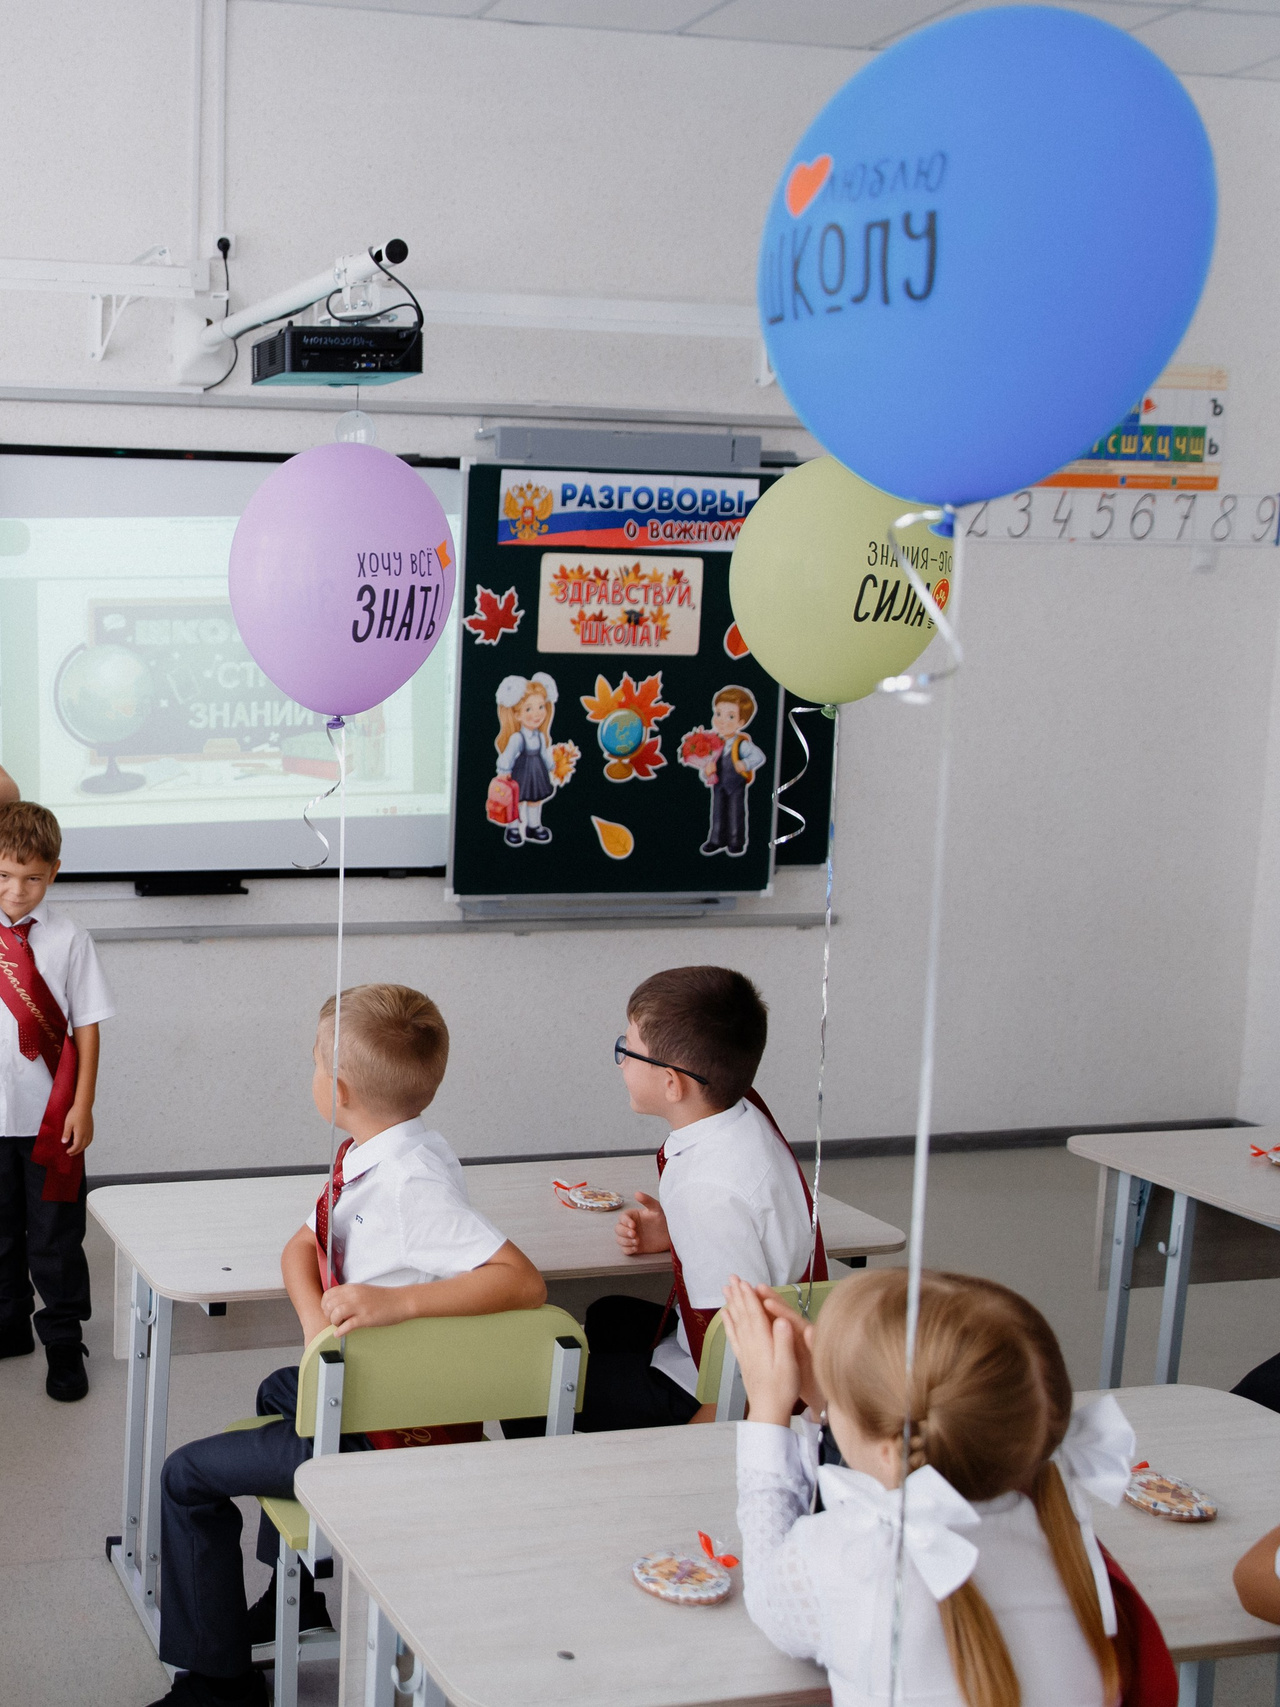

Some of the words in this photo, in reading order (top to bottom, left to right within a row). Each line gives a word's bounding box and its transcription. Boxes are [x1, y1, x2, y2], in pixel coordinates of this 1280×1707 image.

[763, 210, 937, 326] ШКОЛУ
[561, 483, 745, 514] РАЗГОВОРЫ
[1007, 491, 1033, 538] 3
[1052, 491, 1073, 538] 4
[1090, 492, 1118, 539] 5
[1129, 492, 1156, 541] 6
[1175, 493, 1198, 540] 7
[1211, 495, 1238, 541] 8
[1252, 495, 1277, 542] 9
[357, 552, 402, 577] ХОЧУ
[410, 548, 433, 577] ВСЁ
[352, 584, 440, 643] ЗНАТЬ
[555, 577, 696, 610] ЗДРАВСТВУЙ,
[853, 574, 930, 627] СИЛА
[580, 621, 662, 647] ШКОЛА!
